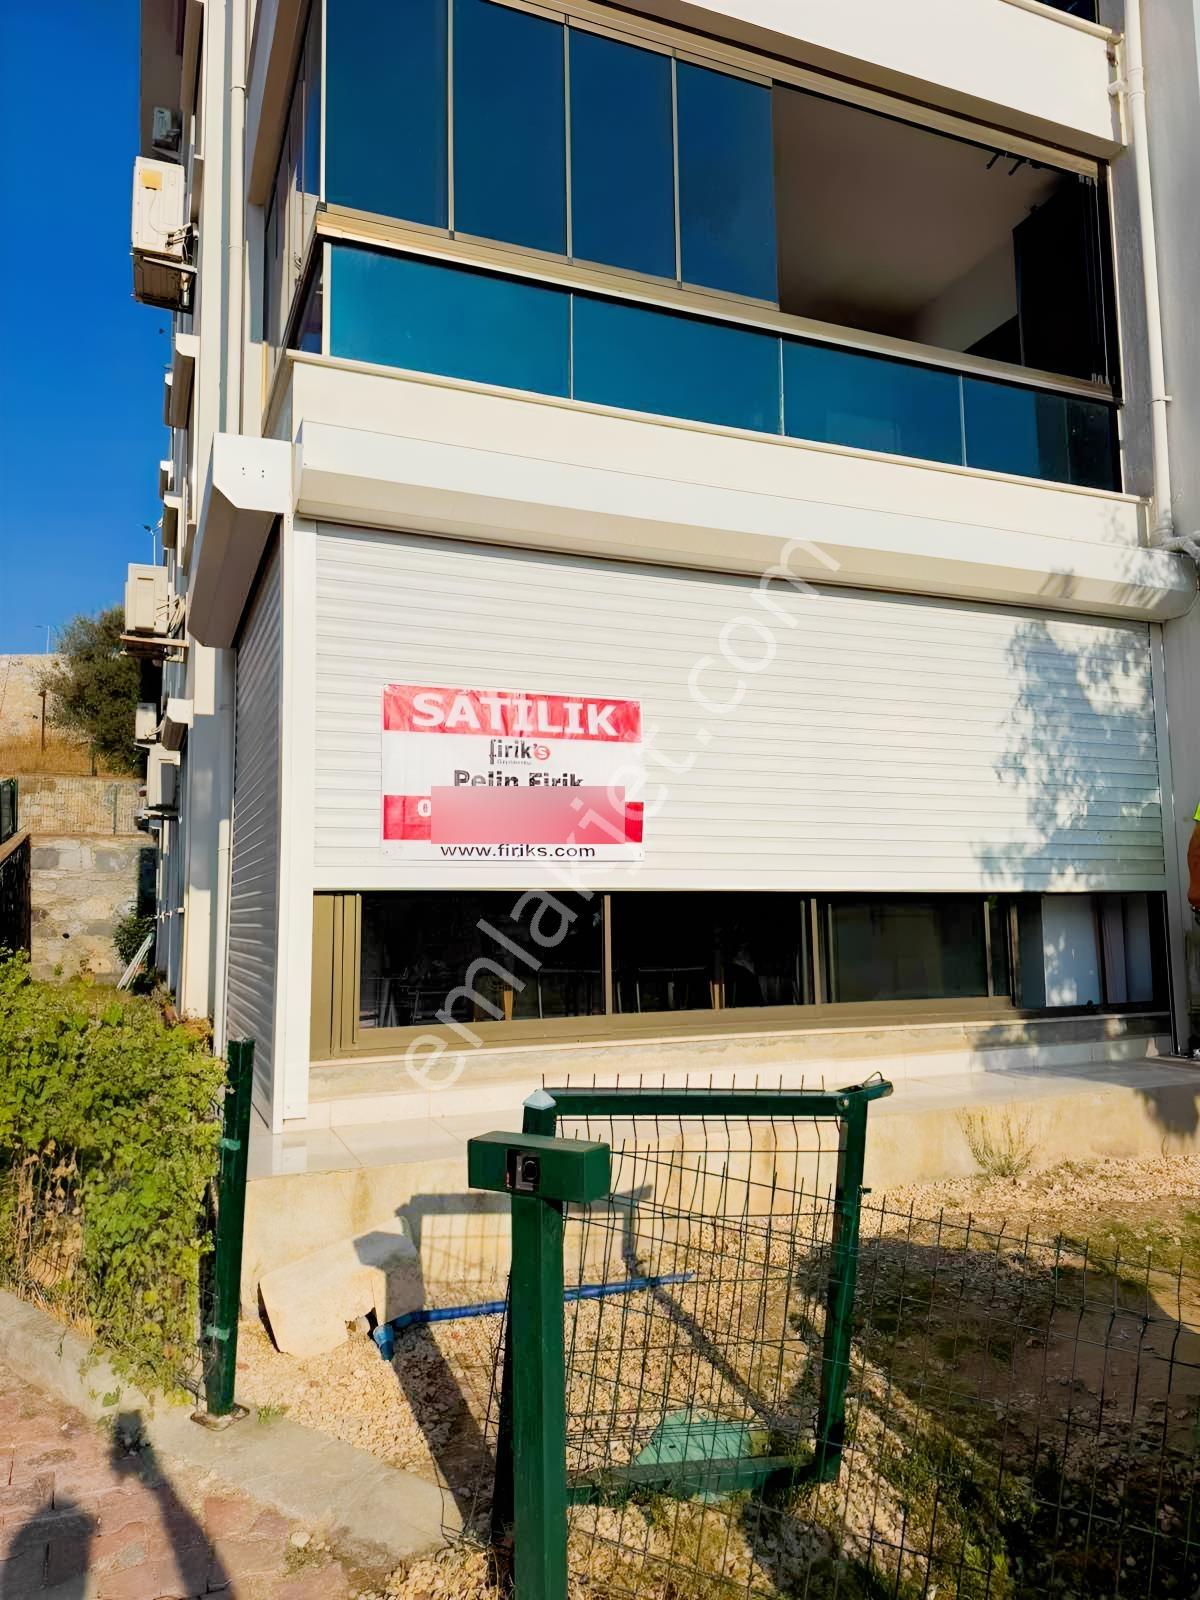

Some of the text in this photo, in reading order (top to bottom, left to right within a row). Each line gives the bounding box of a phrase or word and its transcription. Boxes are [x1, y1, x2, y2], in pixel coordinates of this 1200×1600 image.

[411, 692, 619, 737] SATILIK
[454, 769, 584, 787] Pelin Firik
[440, 843, 596, 857] www.firiks.com
